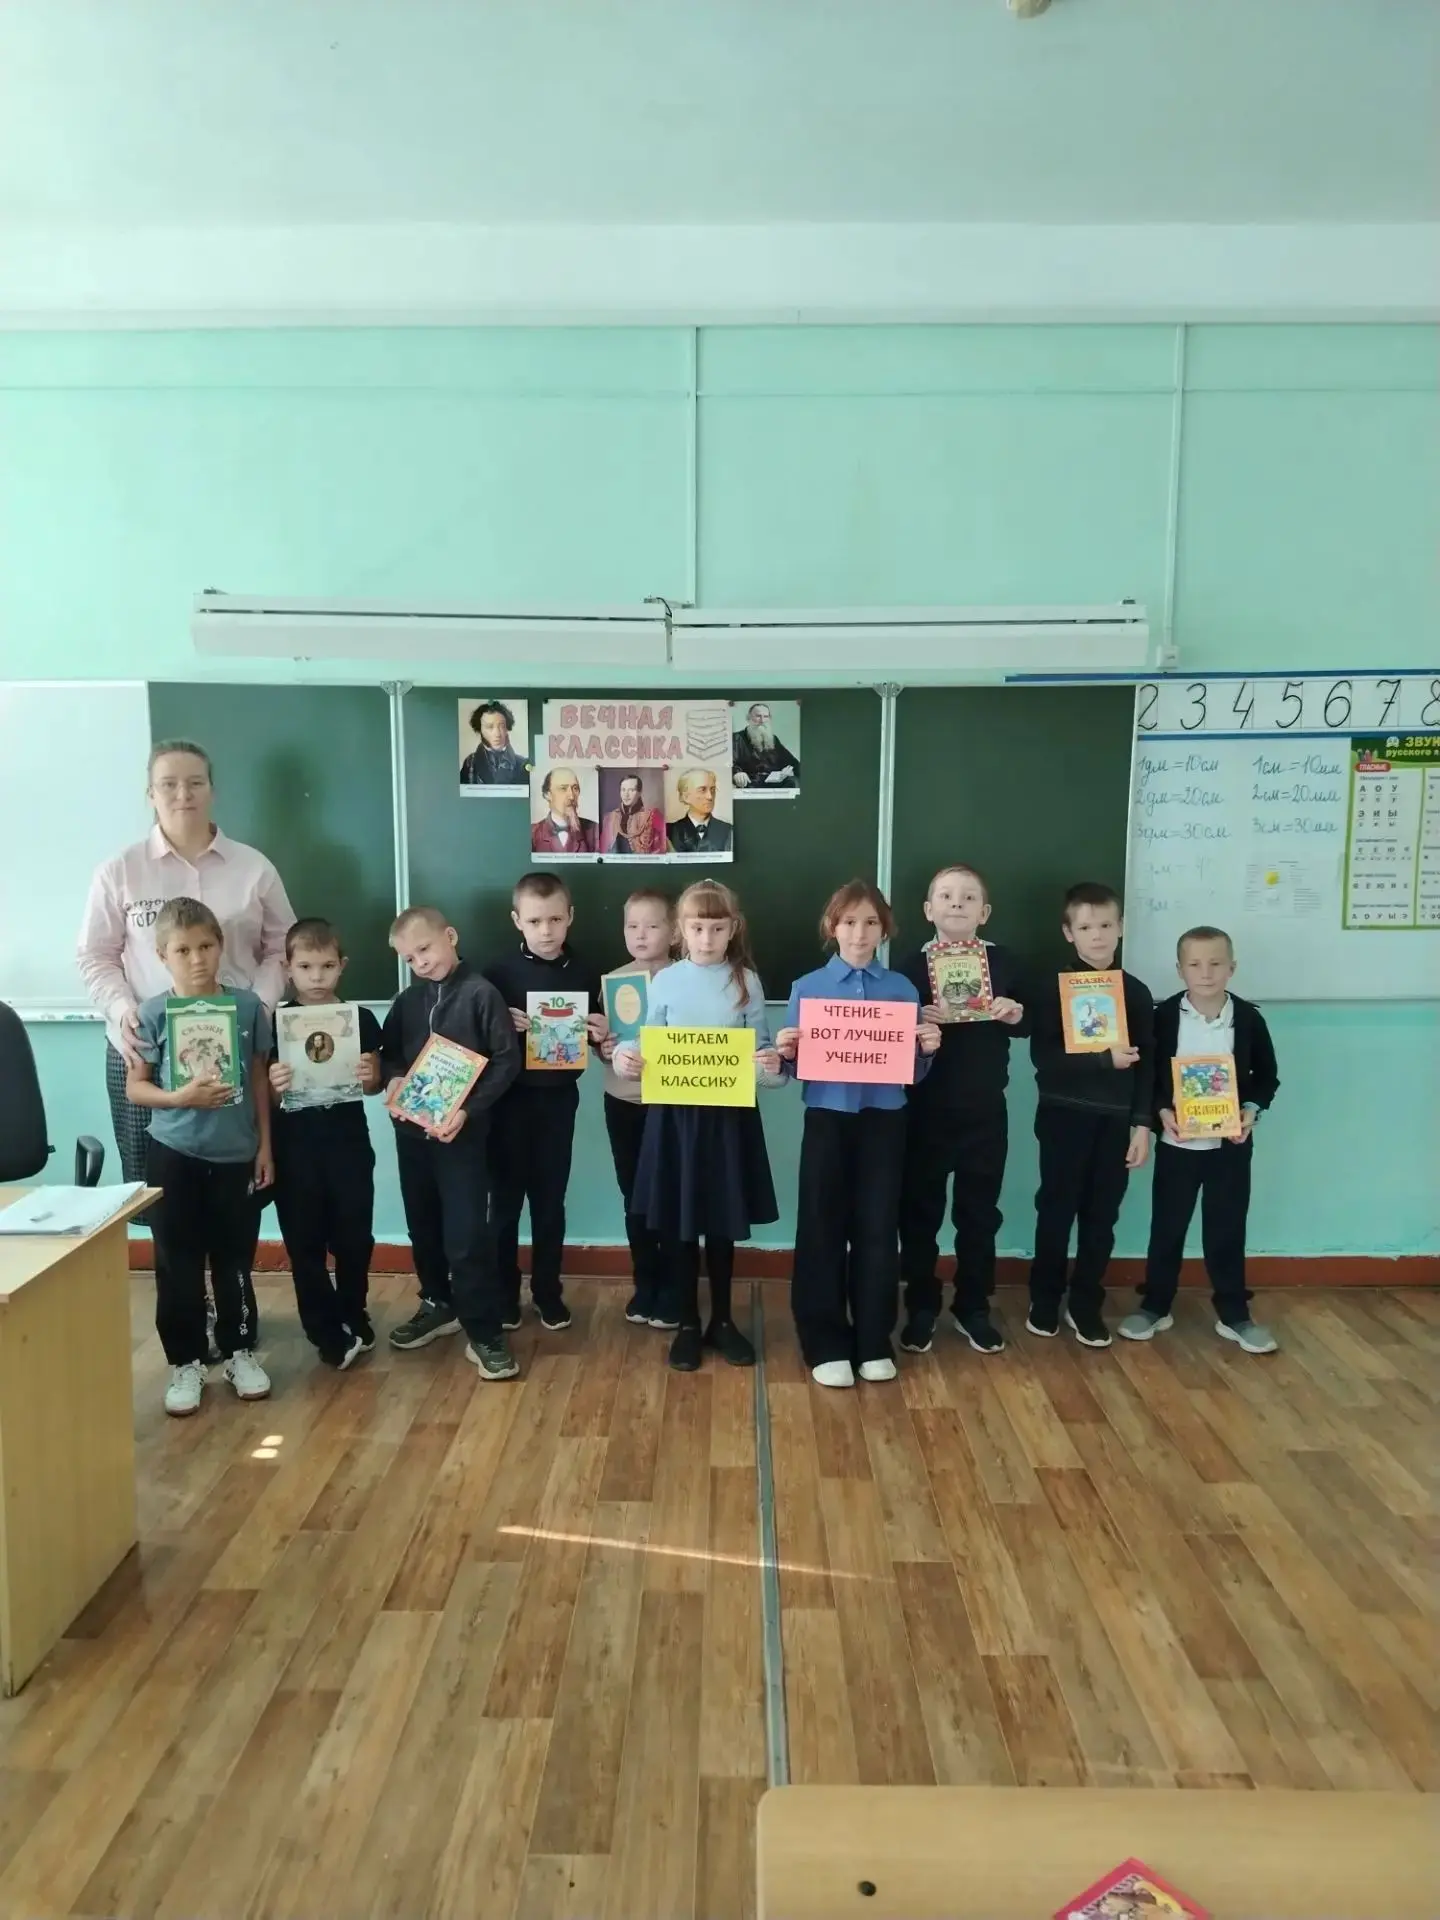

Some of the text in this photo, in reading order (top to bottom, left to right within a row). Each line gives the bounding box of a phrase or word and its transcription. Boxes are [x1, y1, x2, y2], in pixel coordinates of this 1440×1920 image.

[1138, 684, 1159, 730] 2
[1180, 683, 1207, 730] 3
[1232, 681, 1255, 729] 4
[1275, 680, 1304, 728] 5
[1323, 680, 1352, 728] 6
[1376, 679, 1401, 727] 7
[559, 704, 673, 730] ВЕЧНАЯ
[548, 734, 683, 760] КЛАССИКА
[1386, 749, 1432, 757] русского
[1068, 976, 1113, 984] СКАЗКА
[549, 996, 565, 1008] 10
[824, 1005, 881, 1019] ЧТЕНИЕ
[667, 1032, 729, 1044] ЧИТАЕМ
[811, 1027, 904, 1042] ВОТ ЛУЧШЕЕ
[657, 1054, 740, 1066] ЛЮБИМУЮ
[826, 1051, 888, 1064] УЧЕНИЕ!
[660, 1075, 737, 1088] КЛАССИКУ
[1186, 1103, 1229, 1117] СКАЗКИ
